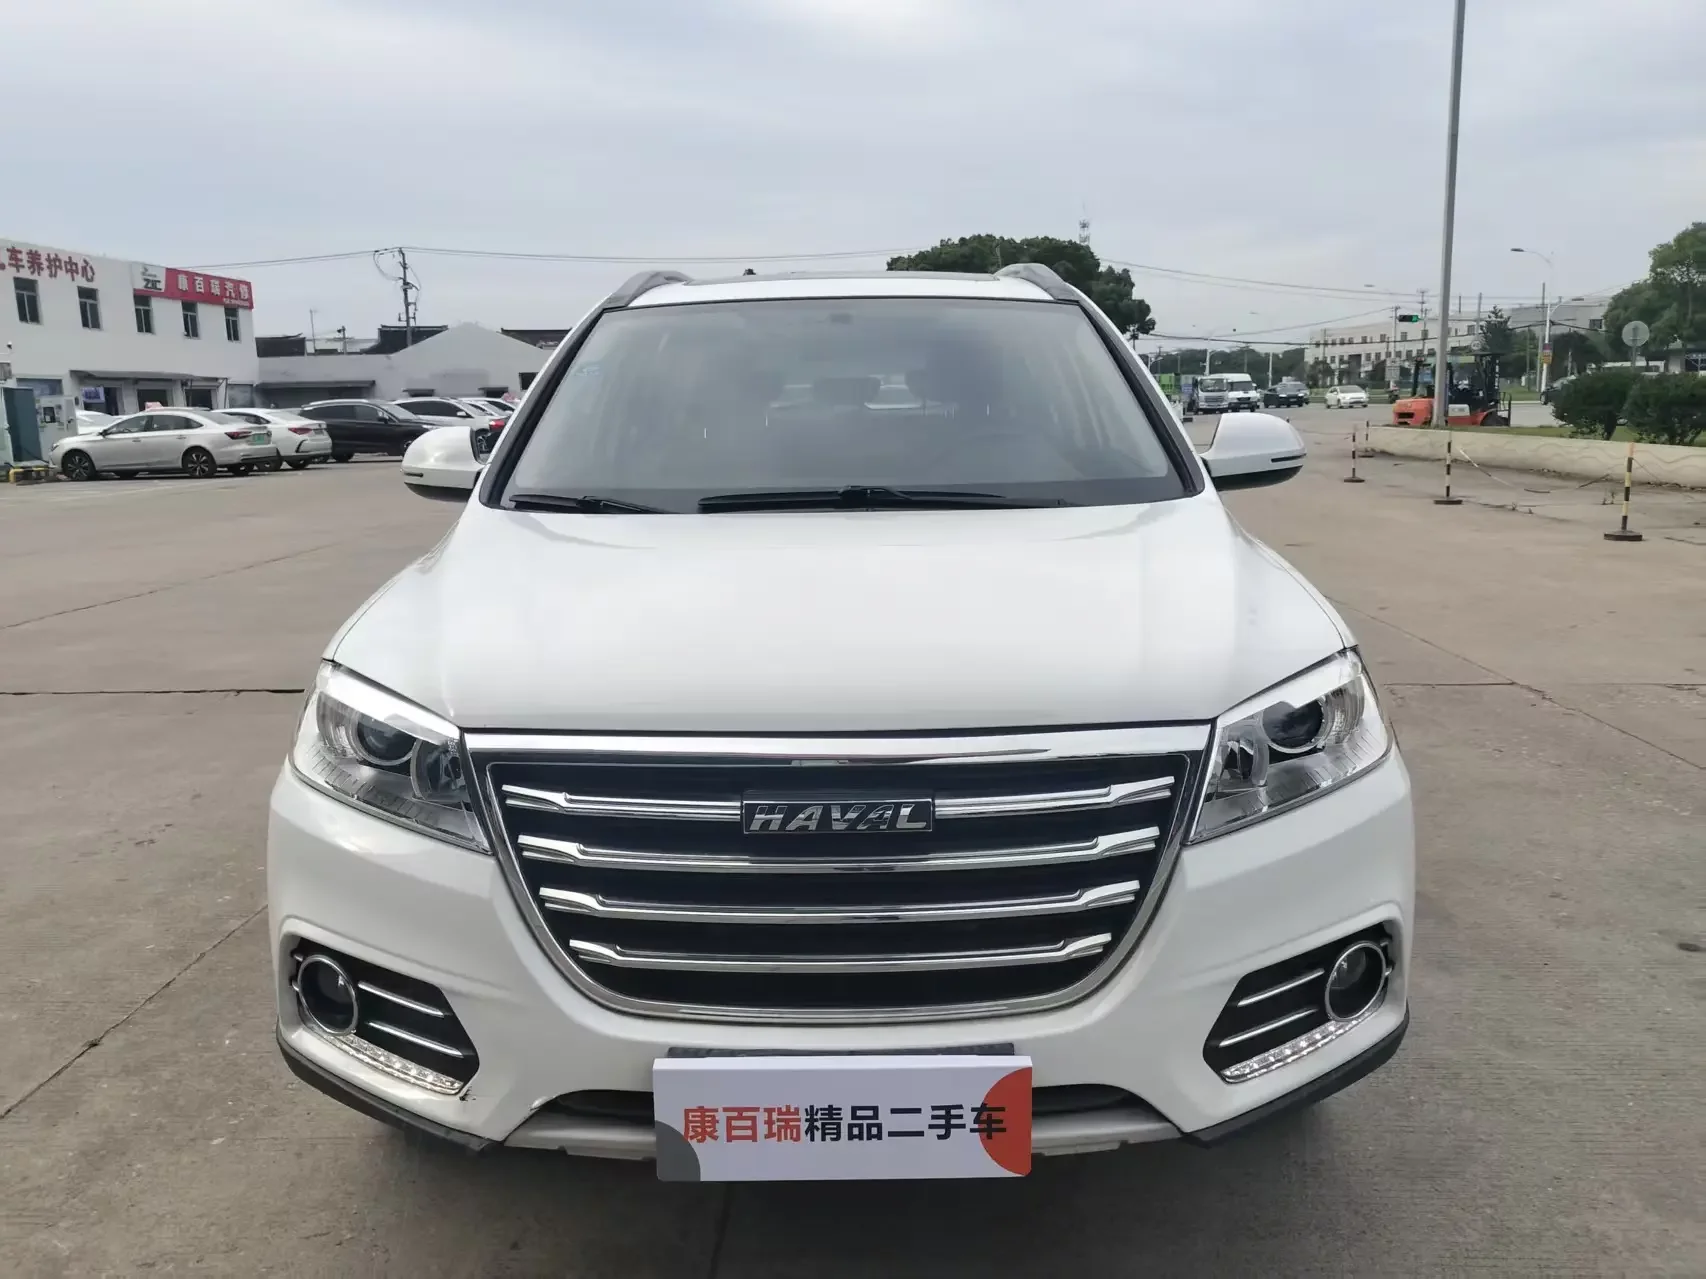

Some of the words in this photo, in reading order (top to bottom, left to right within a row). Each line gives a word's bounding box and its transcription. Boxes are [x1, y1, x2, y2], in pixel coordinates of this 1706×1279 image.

[0, 245, 95, 283] 车养护中心
[750, 803, 927, 831] HAVAL
[683, 1104, 1007, 1143] 康百瑞精品二手车
